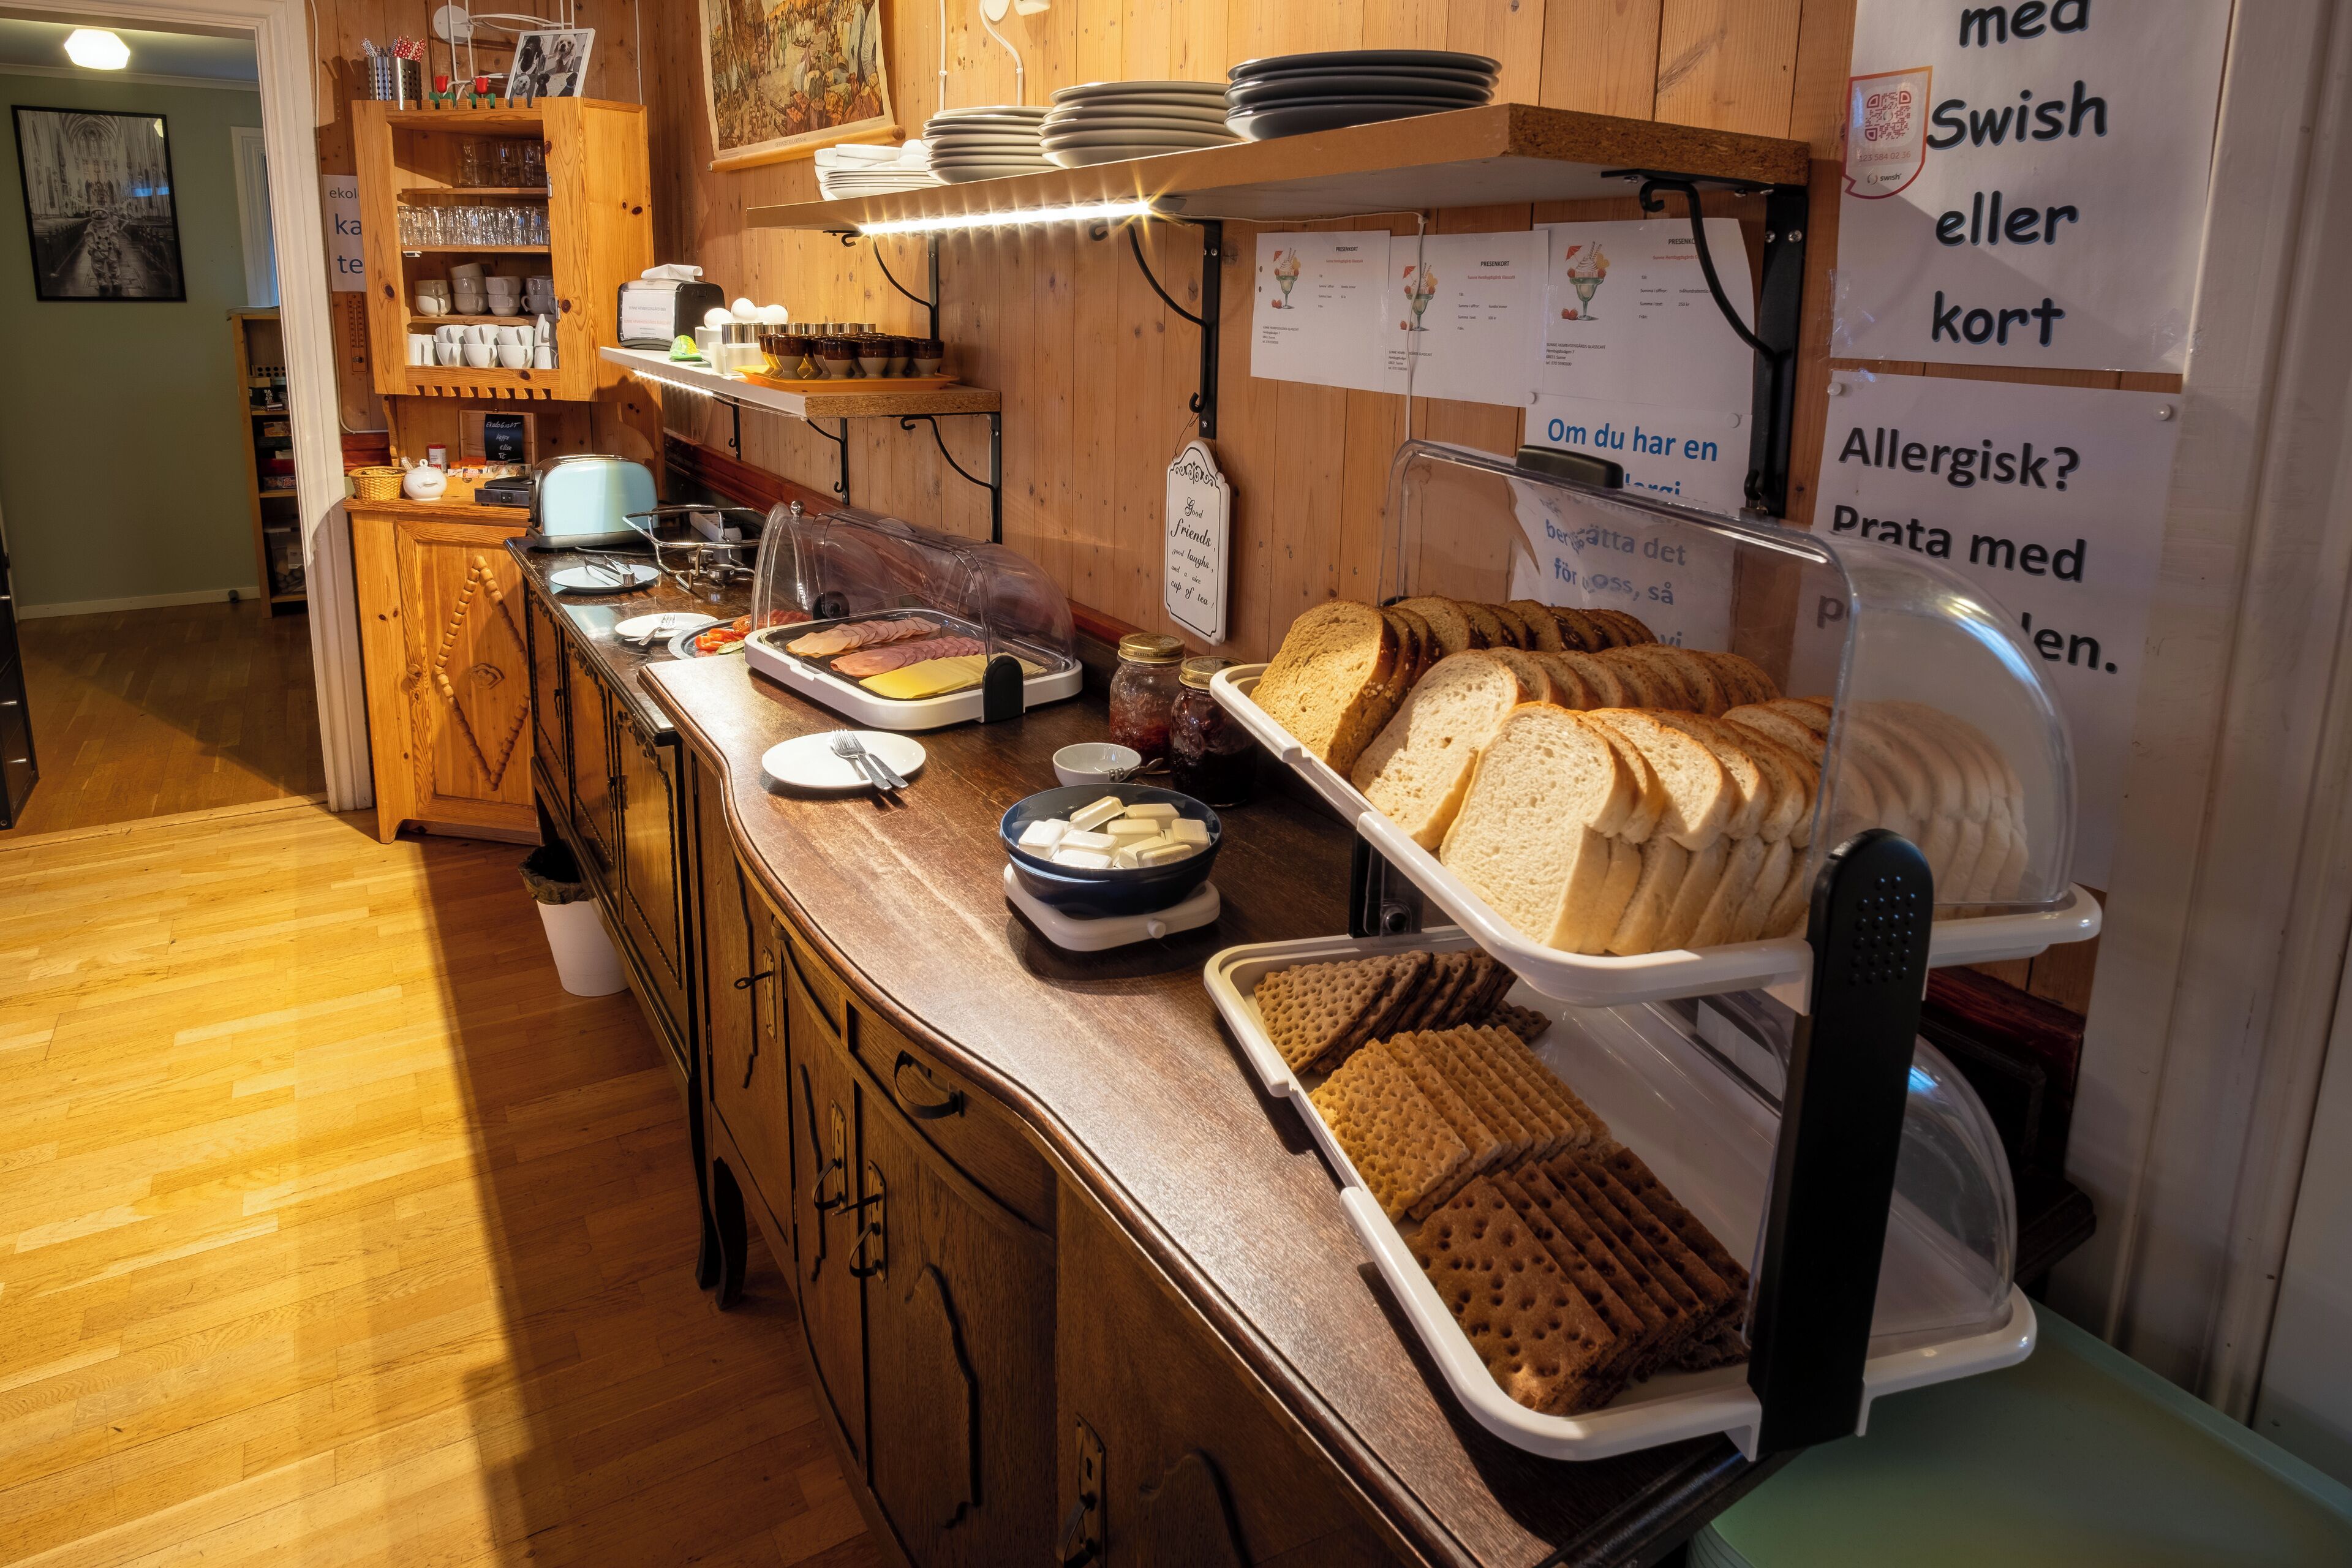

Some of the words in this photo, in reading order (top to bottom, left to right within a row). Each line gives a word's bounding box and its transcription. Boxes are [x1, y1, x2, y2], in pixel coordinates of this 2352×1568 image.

[1926, 81, 2108, 149] Swish
[330, 187, 359, 198] ekol
[1935, 190, 2077, 246] eller
[337, 255, 363, 274] te
[1931, 290, 2064, 347] kort
[1548, 418, 1586, 445] Om
[1594, 423, 1624, 450] du
[1633, 426, 1676, 456] har
[1684, 439, 1718, 462] en
[1839, 427, 2081, 491] Allergisk?
[1185, 497, 1204, 519] Good
[1643, 538, 1686, 566] det
[1970, 533, 2087, 582] med
[1170, 581, 1182, 594] cup
[1185, 587, 1195, 600] of
[1191, 576, 1201, 584] nice
[1648, 581, 1674, 605] så
